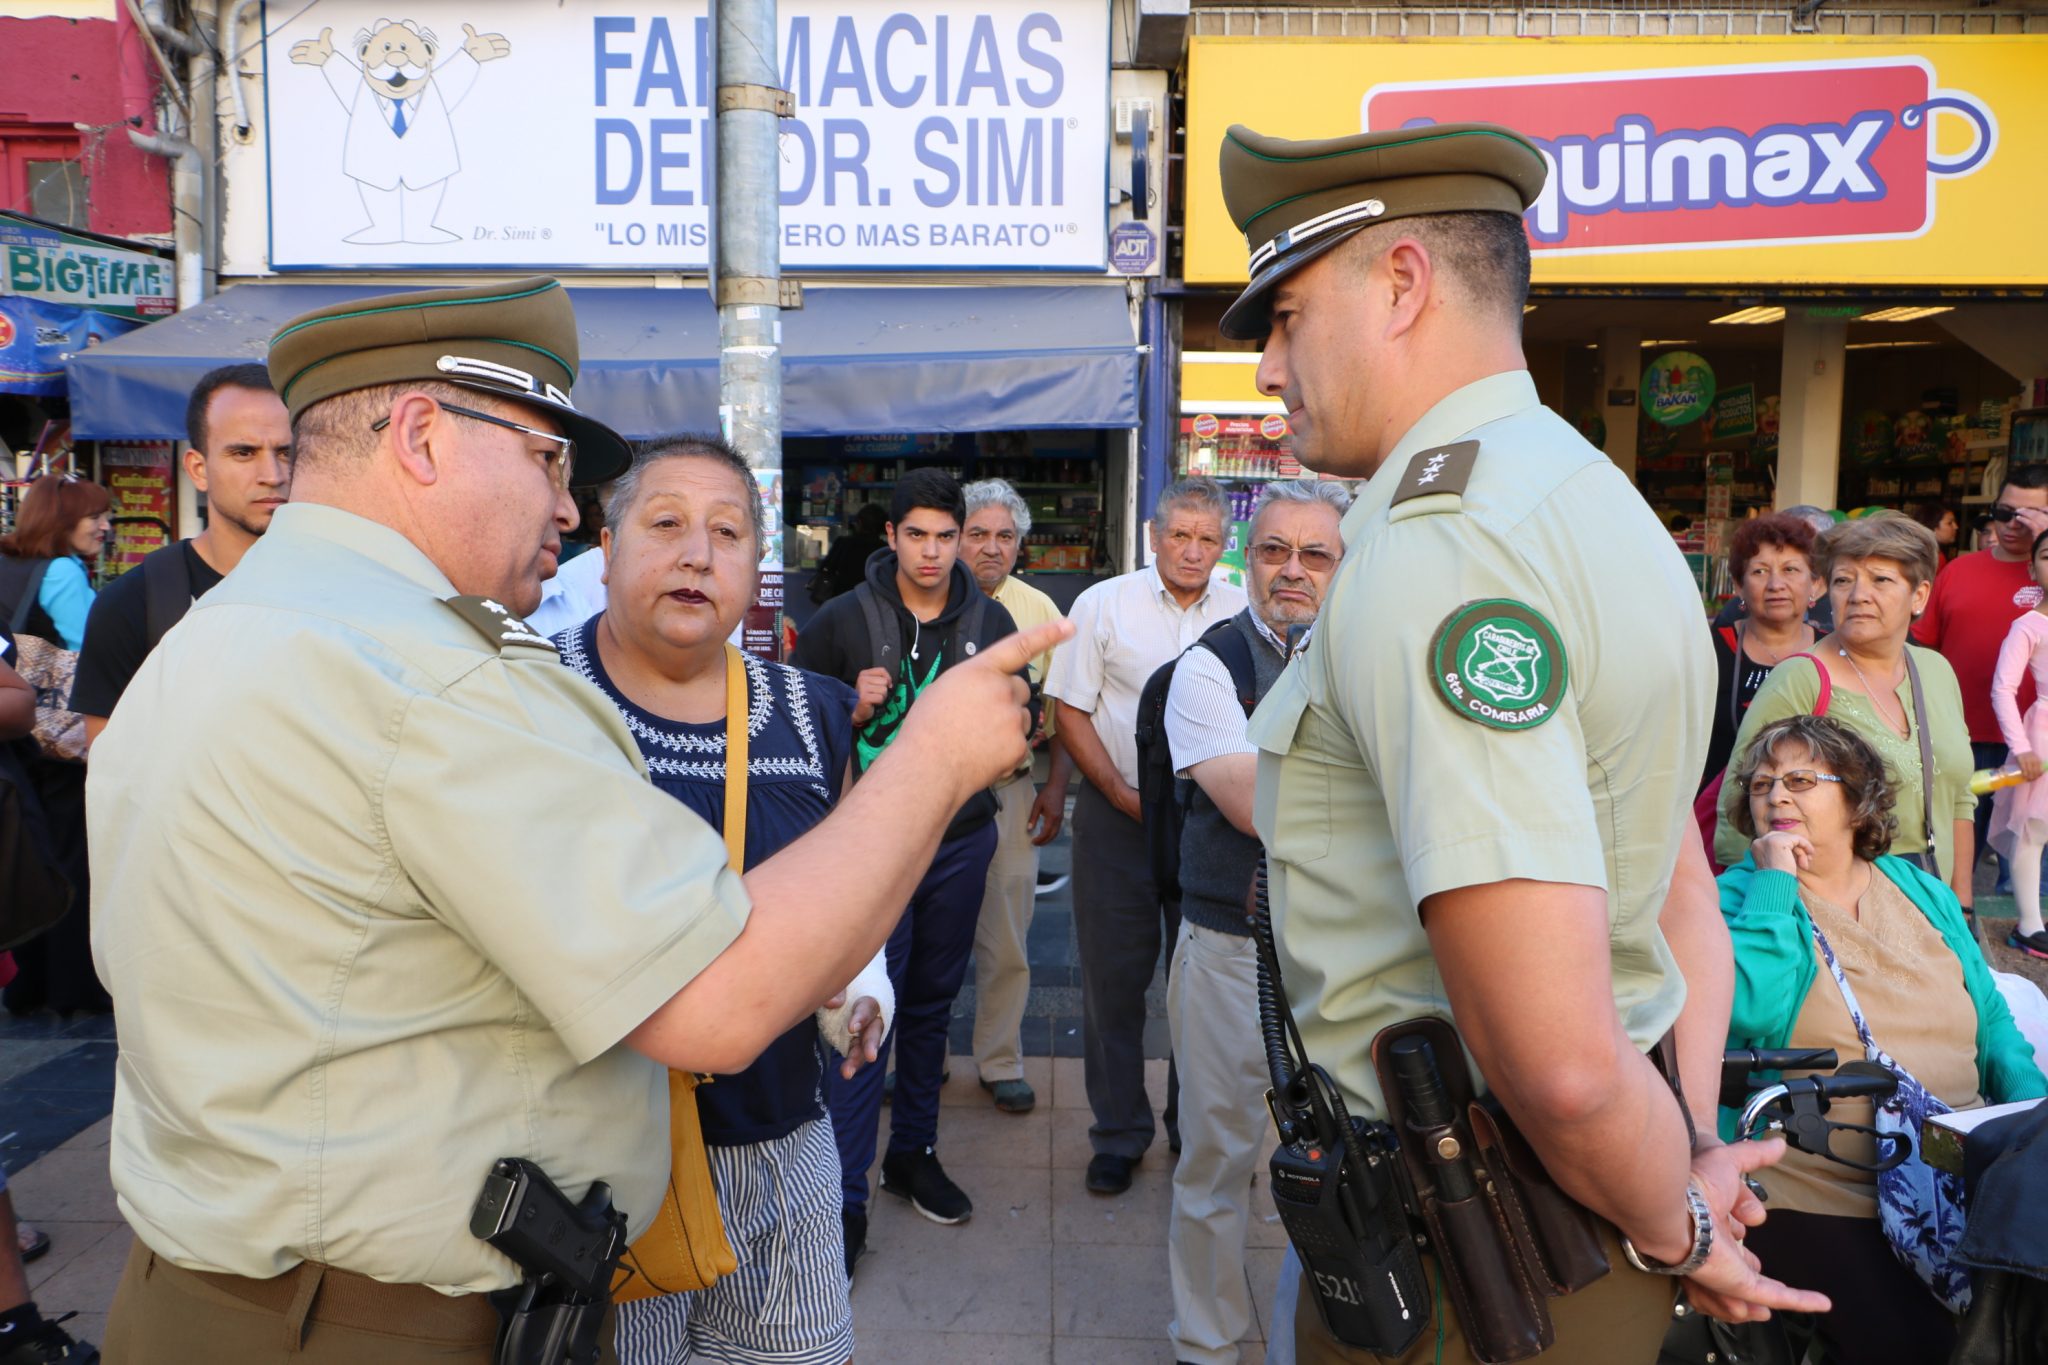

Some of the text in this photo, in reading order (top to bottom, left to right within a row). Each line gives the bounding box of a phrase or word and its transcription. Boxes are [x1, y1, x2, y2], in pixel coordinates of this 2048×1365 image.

[594, 12, 1064, 108] FAMACIAS
[473, 225, 537, 241] Dr. Simi
[778, 224, 846, 247] ERO
[856, 224, 920, 246] MAS
[1115, 238, 1148, 257] ADT
[760, 588, 773, 597] DE
[1482, 631, 1526, 652] CARABINEROS
[1497, 644, 1517, 657] CHILE
[1445, 672, 1463, 699] 6ta.
[1469, 699, 1549, 723] COMISARIA
